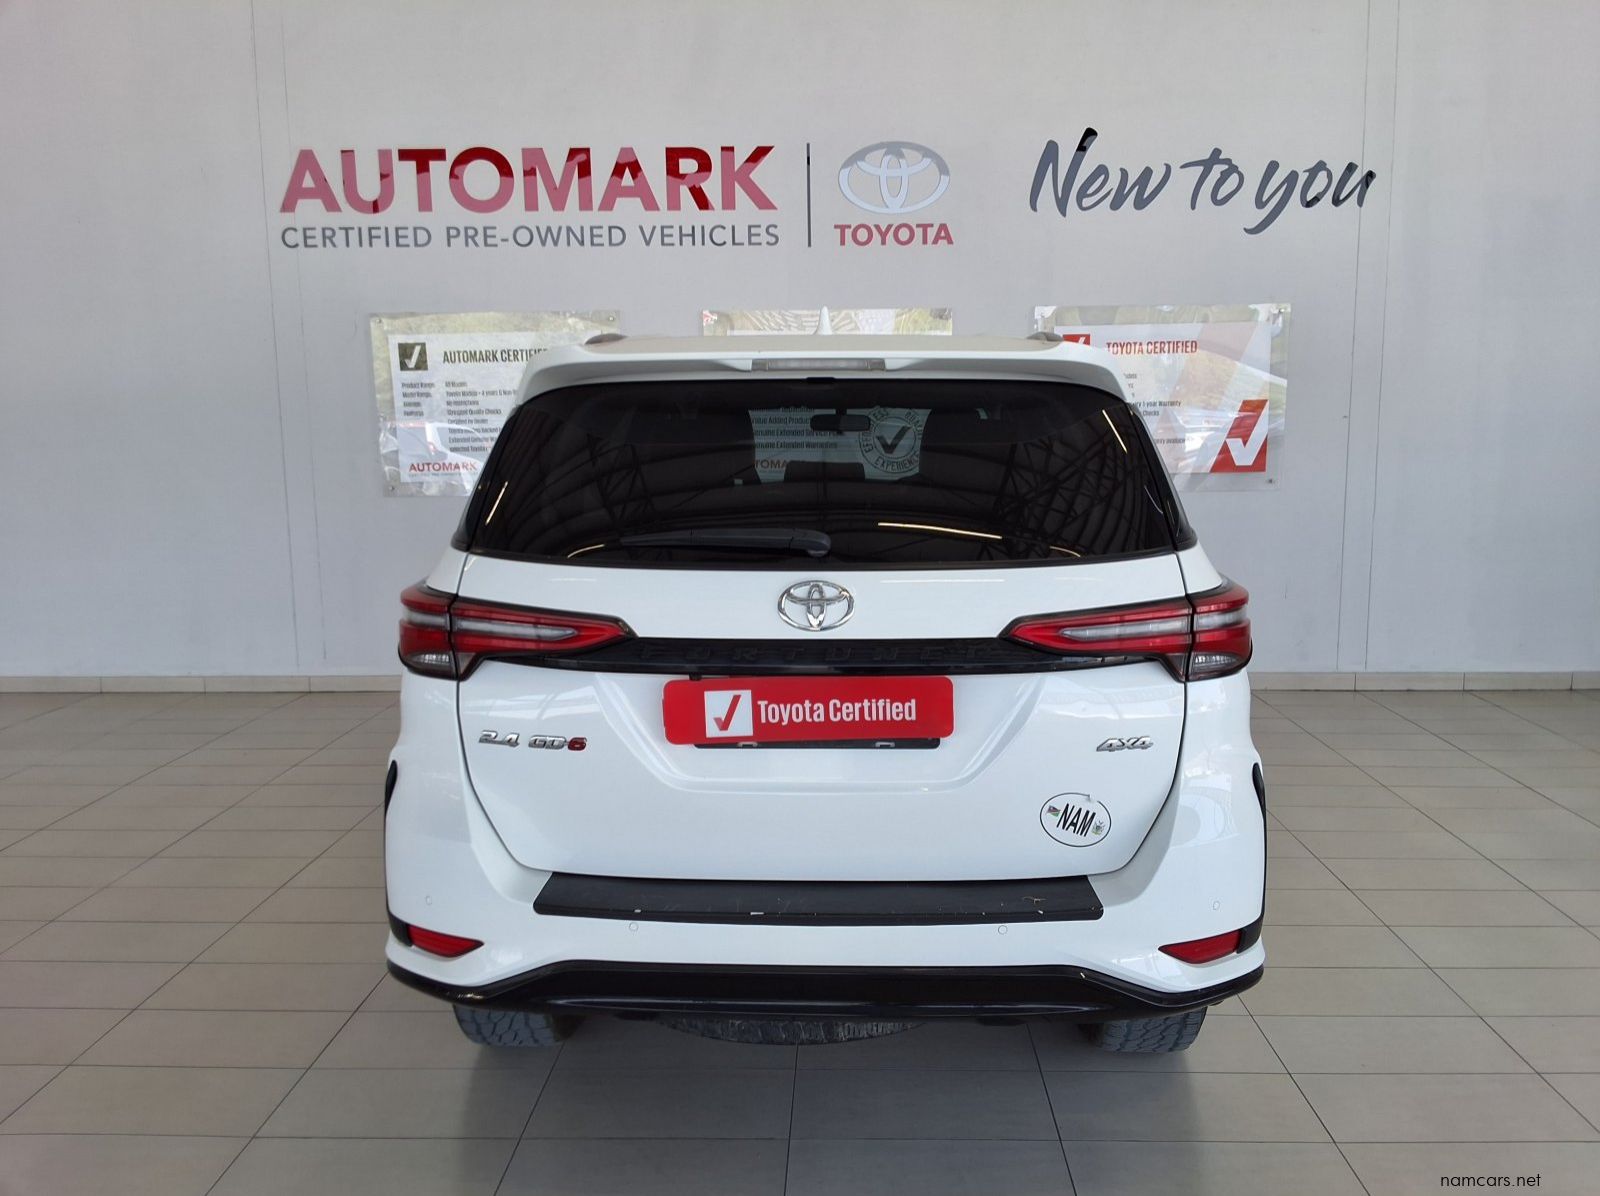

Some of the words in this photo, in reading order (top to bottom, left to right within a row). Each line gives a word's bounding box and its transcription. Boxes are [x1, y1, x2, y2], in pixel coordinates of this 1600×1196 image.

[279, 144, 778, 214] AUTOMARK
[1029, 127, 1172, 218] New
[1179, 147, 1245, 211] to
[1243, 159, 1377, 235] you
[281, 225, 432, 249] CERTIFIED
[445, 224, 628, 249] PRE-OWNED
[638, 223, 780, 248] VEHICLES
[833, 221, 954, 246] TOYOTA
[442, 349, 499, 364] AUTOMARK
[500, 348, 548, 362] CERTIF
[1106, 341, 1144, 355] TOYOTA
[1146, 340, 1198, 354] CERTIFIED
[409, 462, 478, 472] AUTOMARK
[874, 449, 920, 471] EXPERIENC
[757, 699, 825, 725] Toyota
[829, 698, 916, 723] Certified
[479, 730, 519, 747] 2.4
[1056, 803, 1096, 837] NAM
